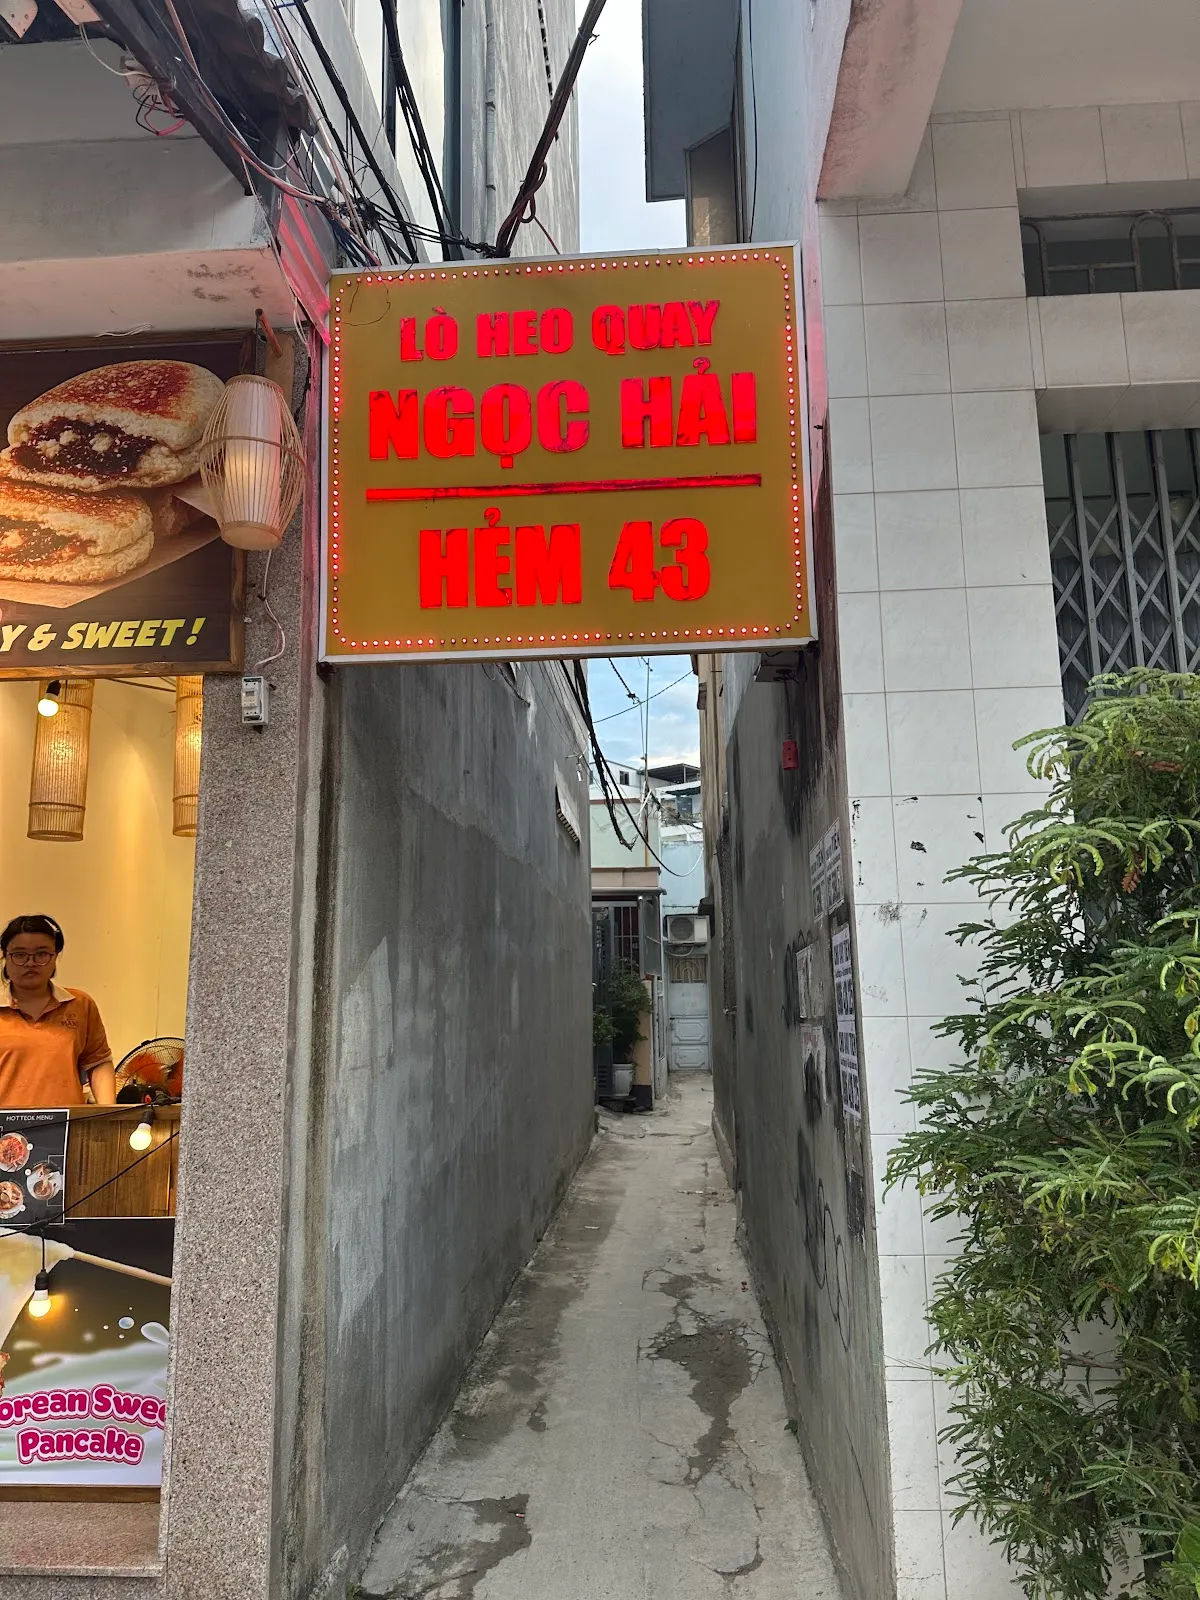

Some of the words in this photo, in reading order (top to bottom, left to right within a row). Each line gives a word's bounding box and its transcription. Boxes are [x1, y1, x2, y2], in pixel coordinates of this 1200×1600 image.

[399, 305, 459, 362] LÒ
[476, 307, 574, 358] HEO
[591, 300, 721, 356] QUAY
[368, 379, 591, 468] NGỌC
[620, 357, 757, 449] HẢI
[418, 507, 582, 609] HẺM
[607, 517, 712, 602] 43
[27, 623, 57, 651] &
[18, 1428, 144, 1463] Pancake
